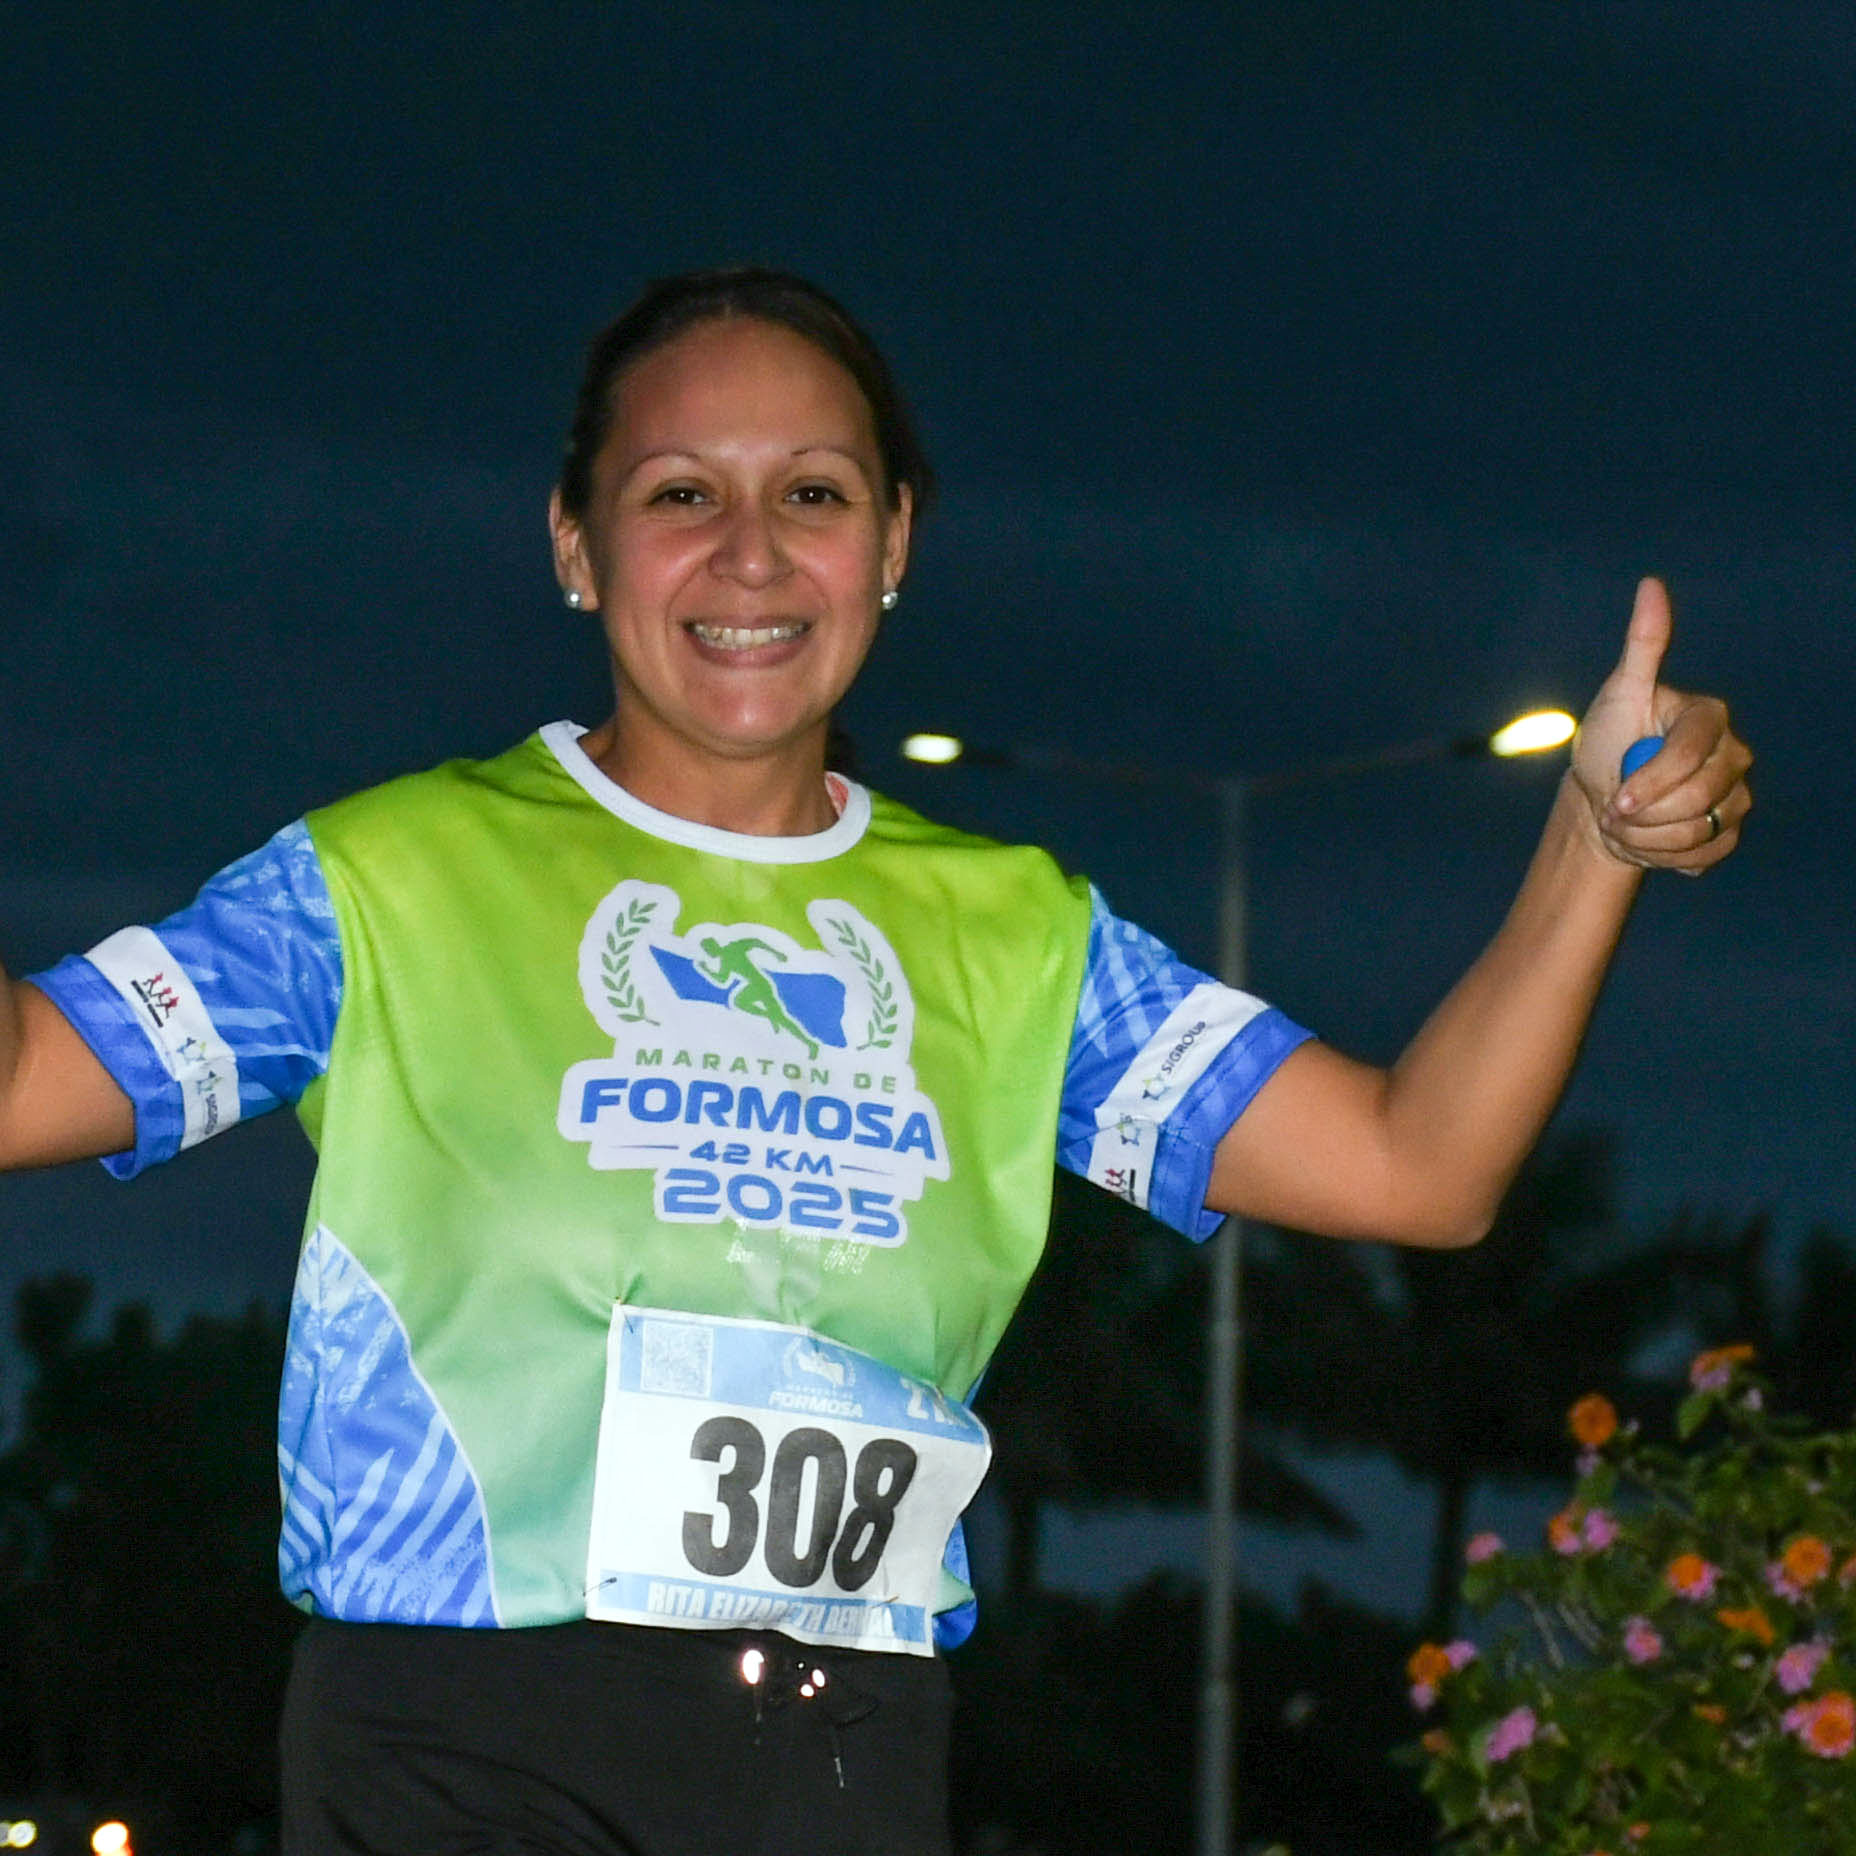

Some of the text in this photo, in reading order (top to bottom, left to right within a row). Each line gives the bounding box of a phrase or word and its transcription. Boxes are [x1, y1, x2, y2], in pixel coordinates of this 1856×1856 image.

[635, 1048, 898, 1094] MARATON DE
[580, 1078, 937, 1160] FORMOSA
[689, 1140, 834, 1177] 42 KM
[662, 1168, 900, 1240] 2025
[768, 1390, 864, 1419] FORMOSA
[682, 1416, 917, 1592] 308
[649, 1582, 706, 1618] RITA
